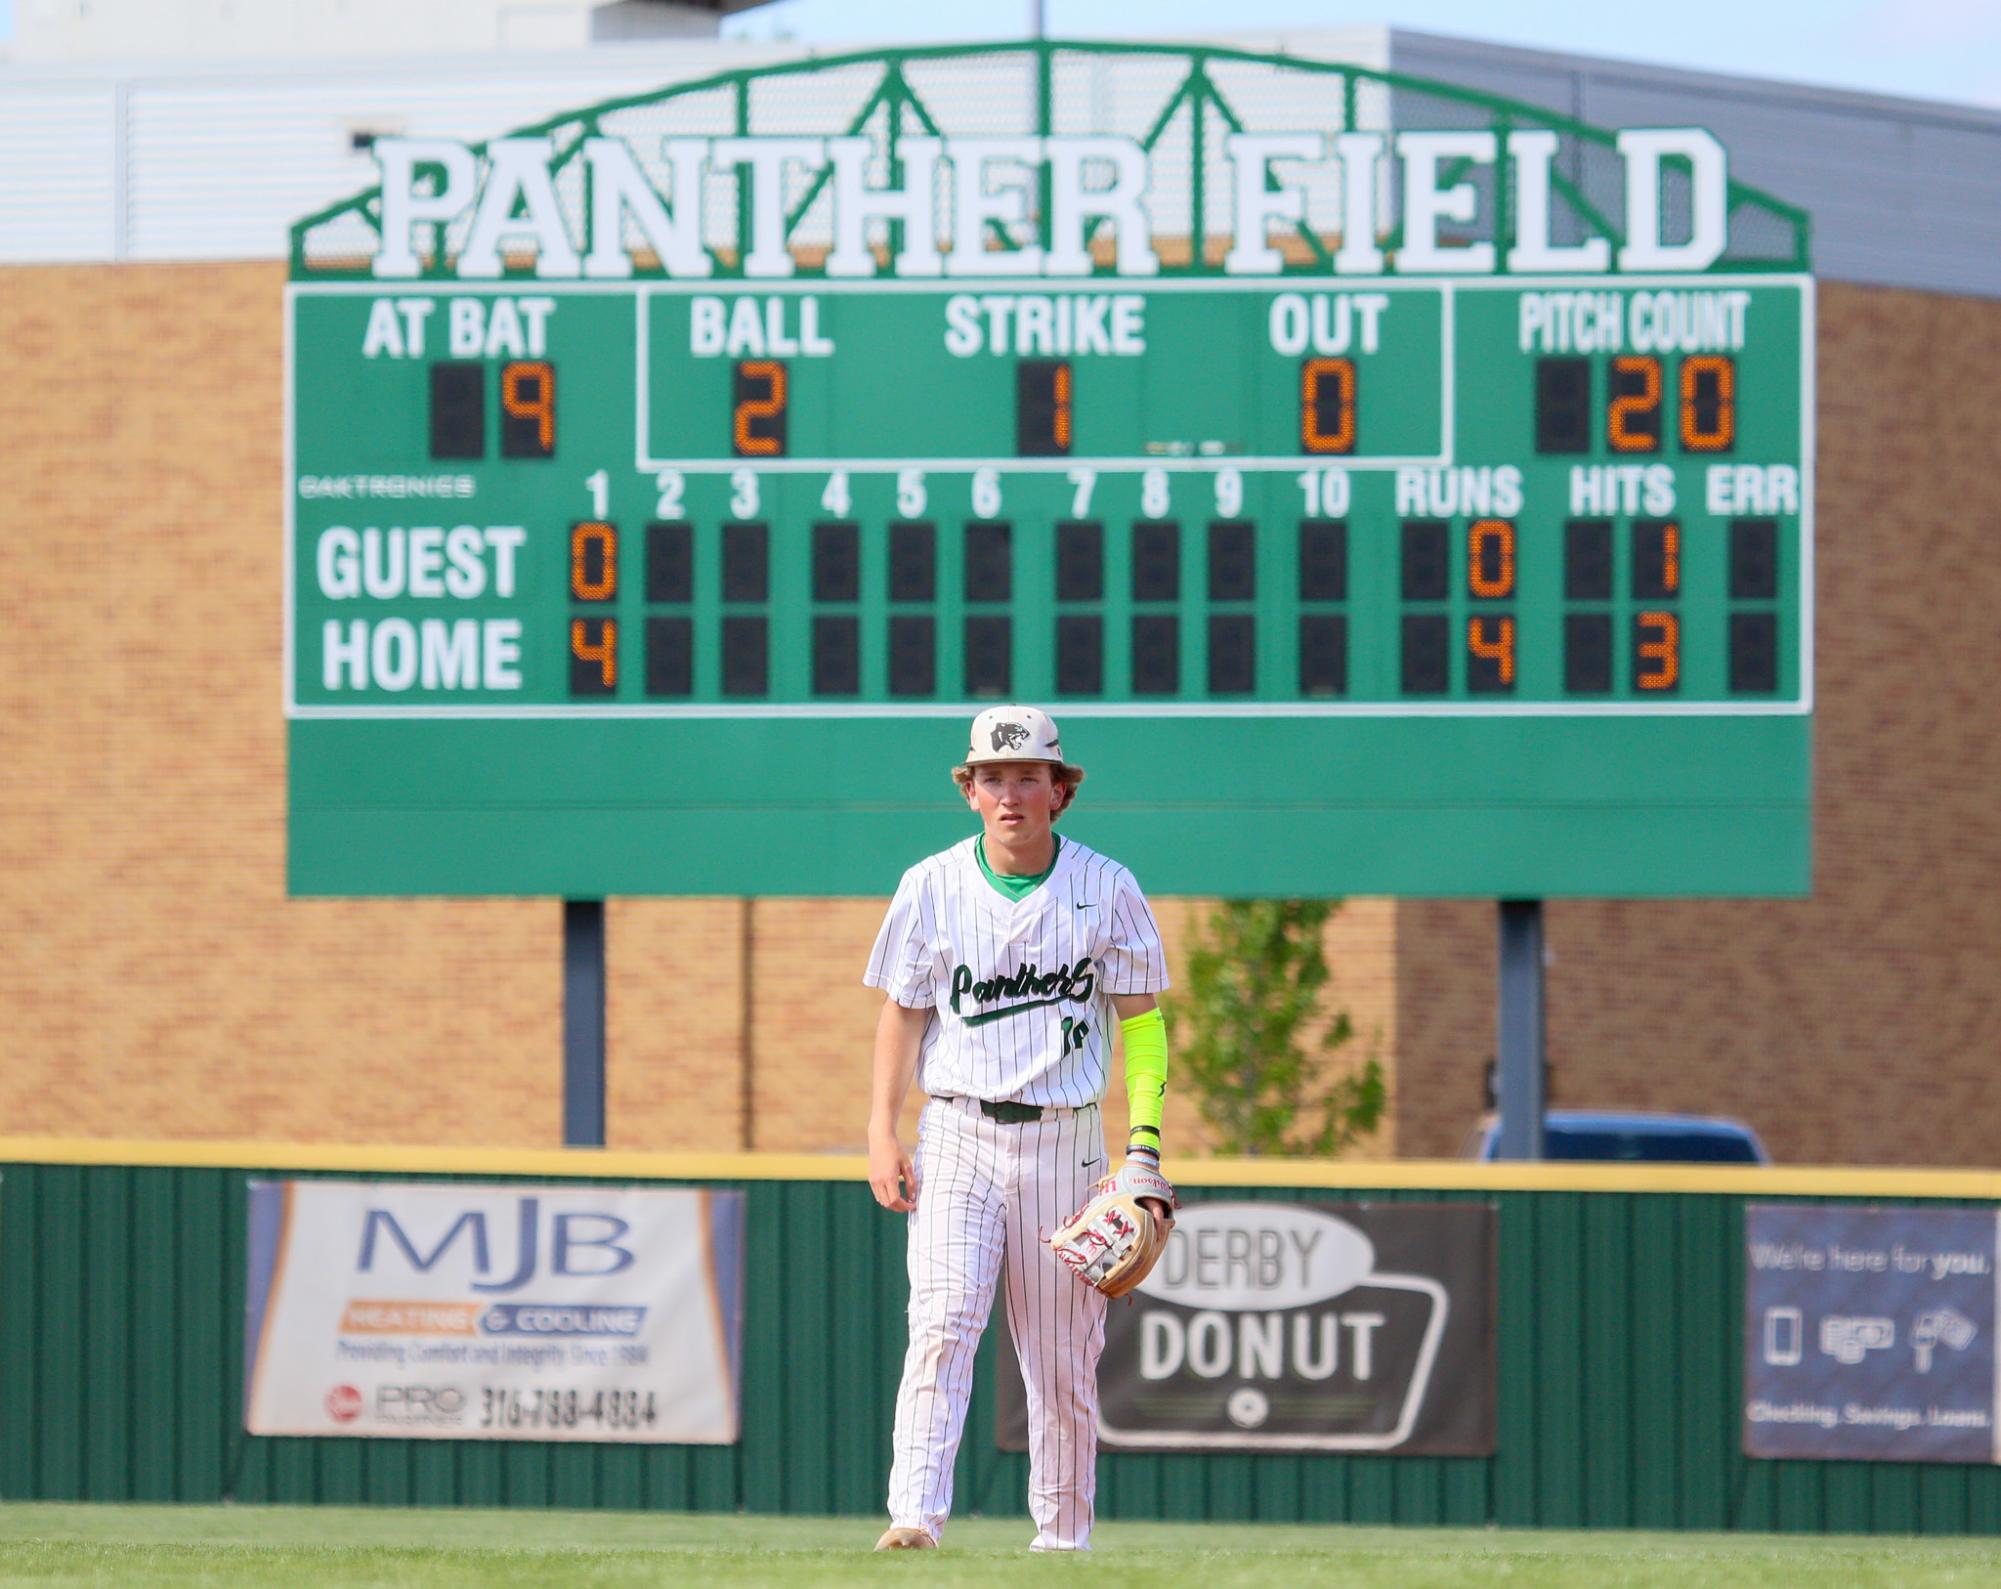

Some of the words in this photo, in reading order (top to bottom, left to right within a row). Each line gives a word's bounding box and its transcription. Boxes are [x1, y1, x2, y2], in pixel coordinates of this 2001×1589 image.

[371, 136, 1159, 278] PANTHER
[1225, 128, 1728, 275] FIELD
[364, 298, 434, 358] AT
[449, 297, 556, 358] BAT
[690, 296, 834, 357] BALL
[944, 295, 1146, 357] STRIKE
[1269, 293, 1388, 357] OUT
[1519, 291, 1623, 353] PITCH
[1629, 291, 1751, 352] COUNT
[503, 362, 554, 449] 9
[734, 361, 786, 454] 2
[1053, 364, 1071, 448] 1
[1302, 359, 1355, 452] 0
[1608, 356, 1734, 450] 20
[586, 470, 608, 520] 1
[656, 469, 685, 520] 2
[731, 470, 760, 520] 3
[821, 470, 850, 518] 4
[897, 469, 927, 518] 5
[971, 469, 1001, 519] 6
[1069, 468, 1096, 518] 7
[1141, 468, 1170, 518] 8
[1215, 467, 1243, 518] 9
[1299, 467, 1350, 517] 10
[1395, 465, 1523, 518] RUNS
[1570, 465, 1675, 517] HITS
[1706, 464, 1799, 515] ERR
[316, 526, 526, 600] GUEST
[571, 522, 617, 600] 0
[1468, 519, 1514, 597] 0
[1663, 524, 1679, 591] 1
[323, 617, 522, 691] HOME
[571, 618, 616, 687] 4
[1468, 617, 1513, 684] 4
[1639, 611, 1678, 689] 3
[357, 1196, 634, 1293] MJB
[1164, 1229, 1322, 1290] DERBY
[1829, 1243, 1888, 1272] here
[1139, 1312, 1385, 1381] DONUT
[375, 1384, 467, 1414] PRO
